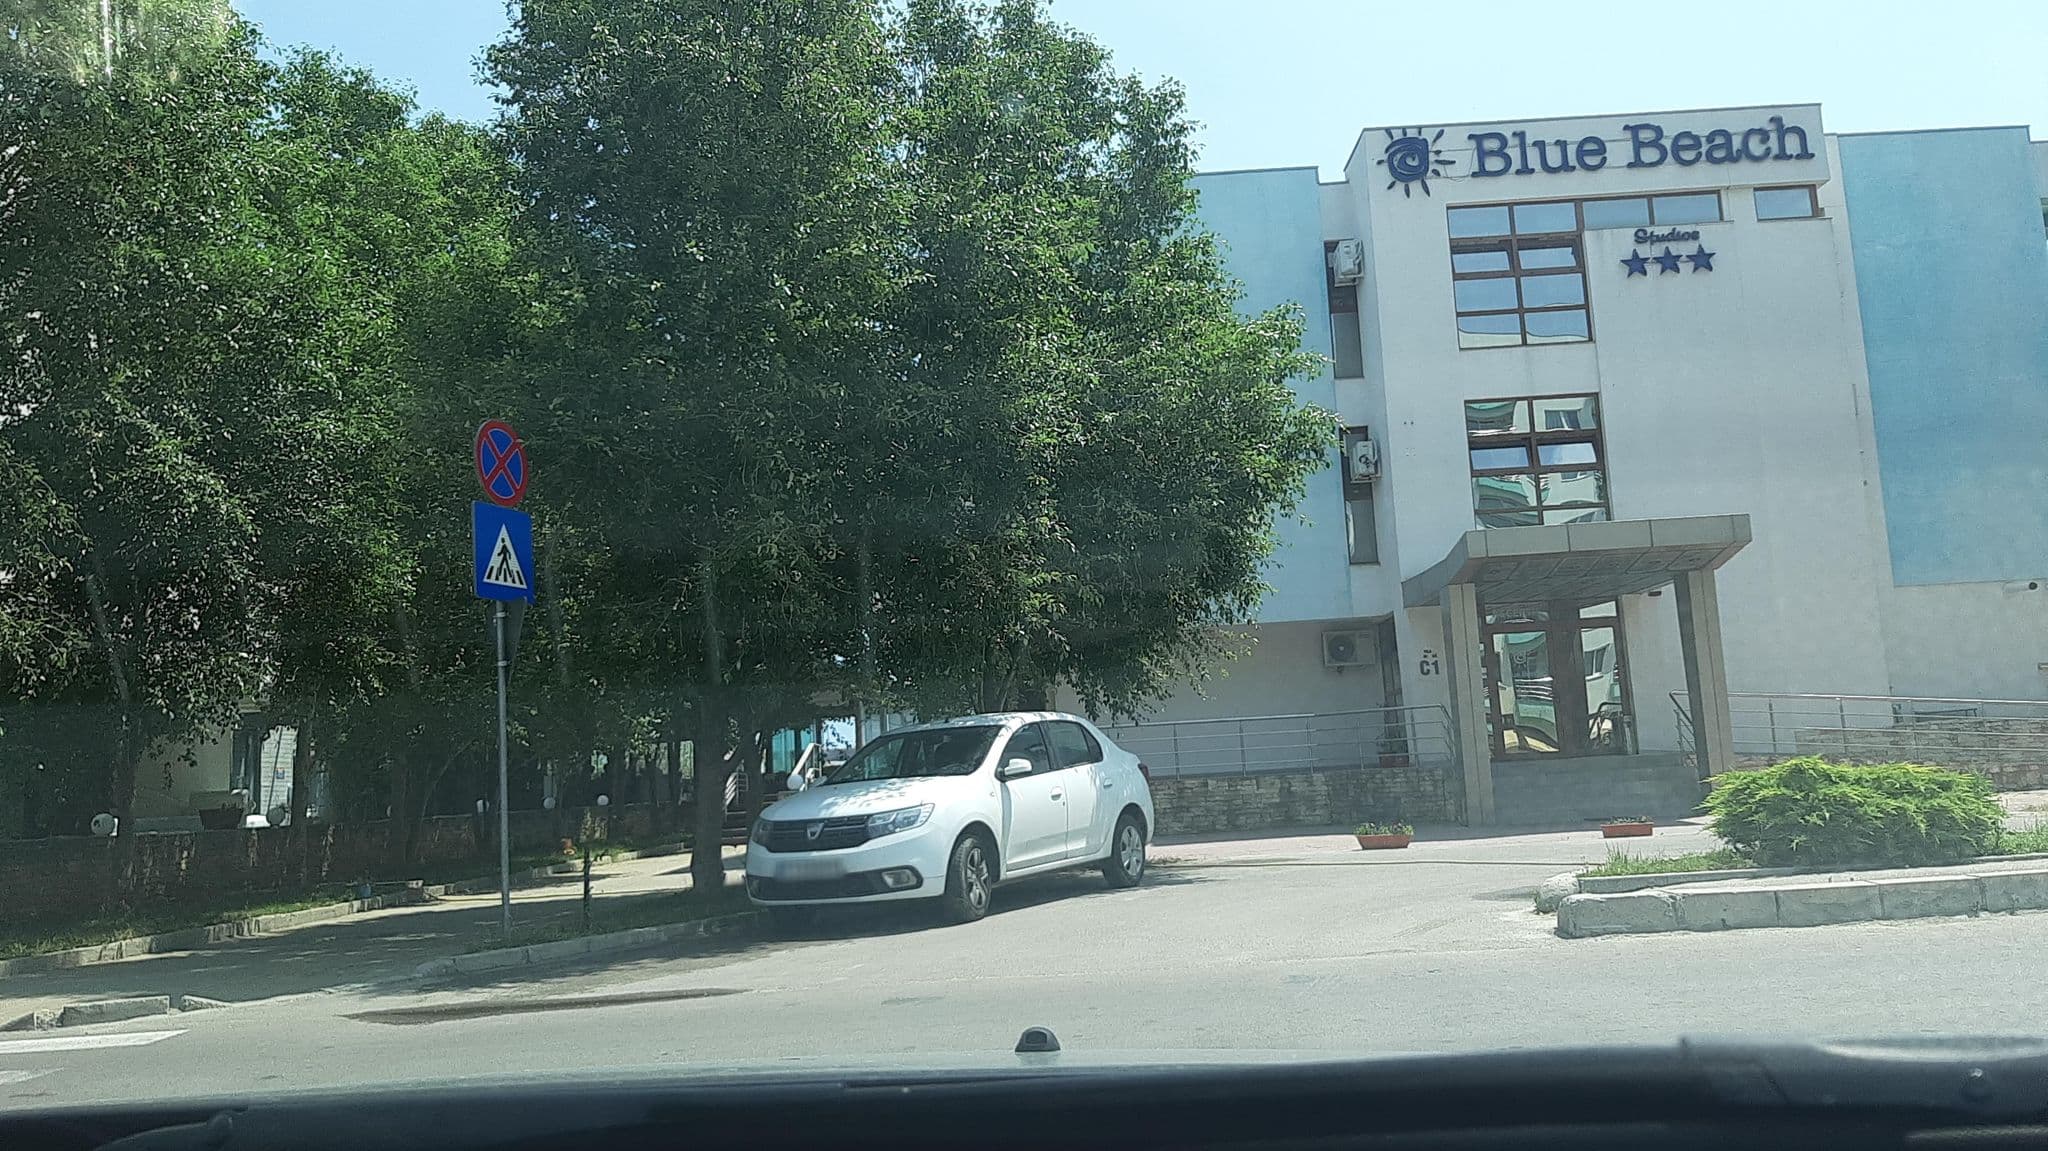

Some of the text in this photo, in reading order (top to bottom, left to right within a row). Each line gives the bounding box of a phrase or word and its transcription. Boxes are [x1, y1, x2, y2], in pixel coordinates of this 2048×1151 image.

[1467, 115, 1816, 178] Blue Beach
[1633, 227, 1700, 245] Studios
[1420, 660, 1440, 676] C1
